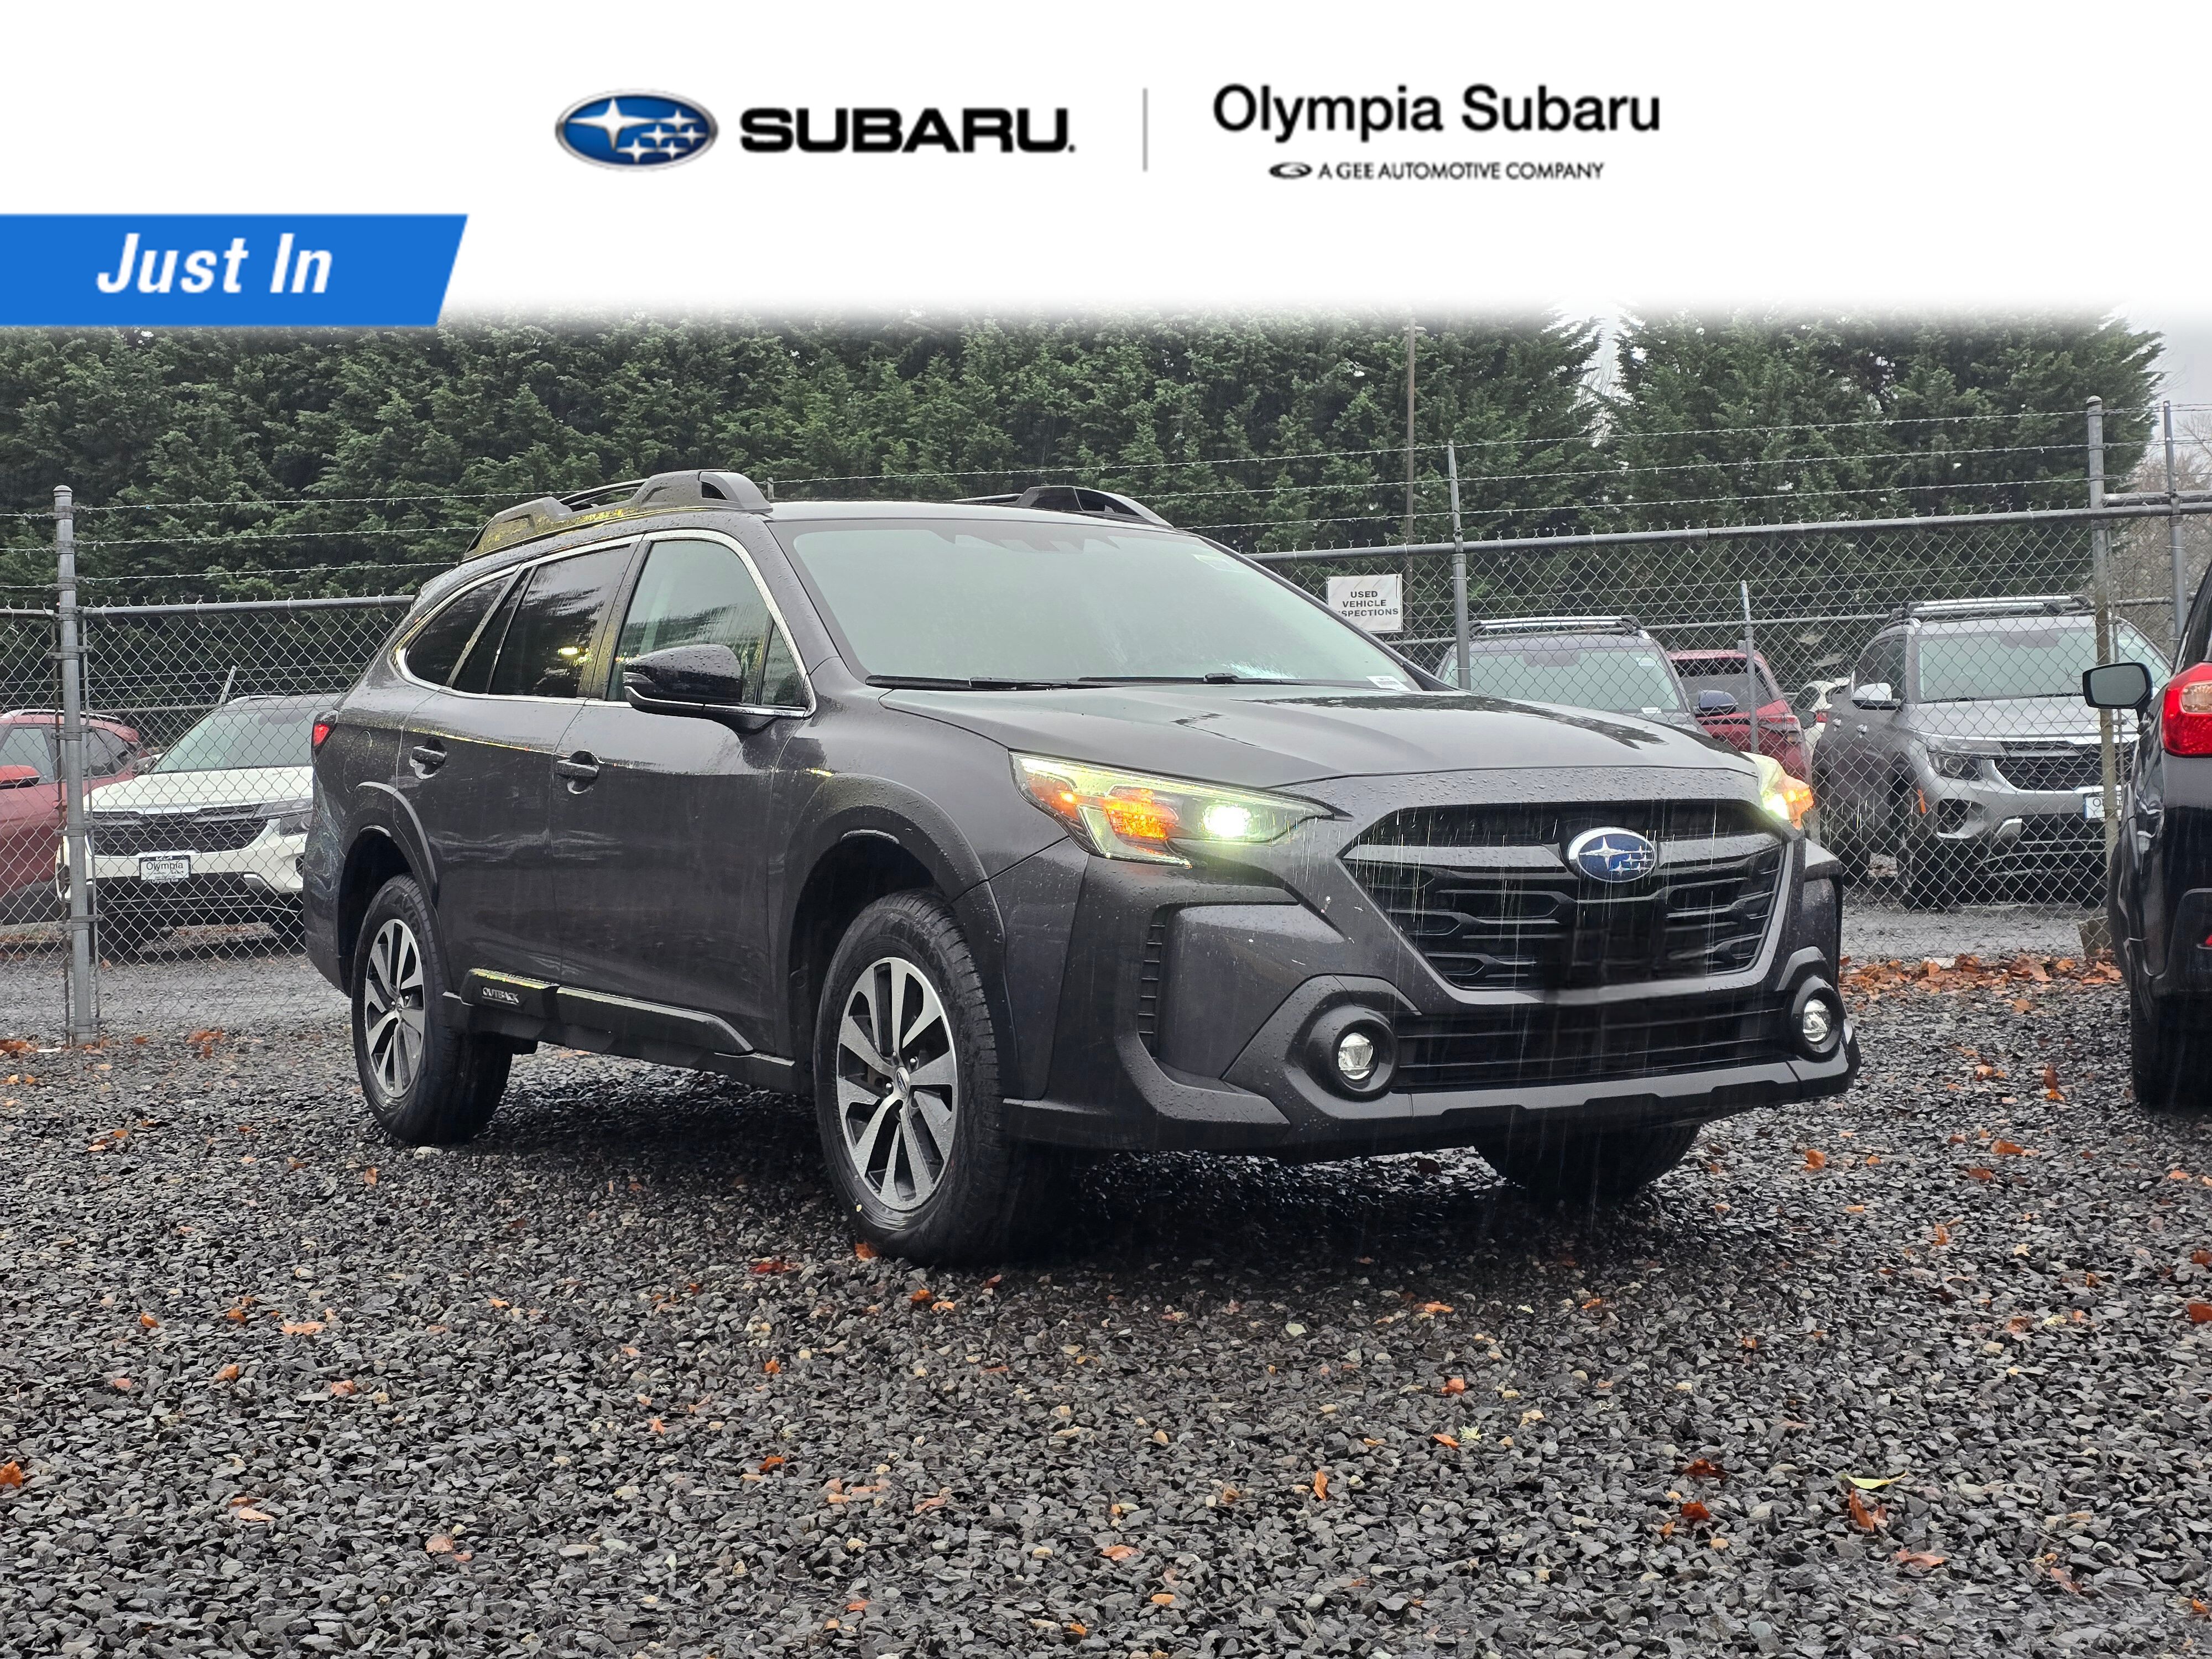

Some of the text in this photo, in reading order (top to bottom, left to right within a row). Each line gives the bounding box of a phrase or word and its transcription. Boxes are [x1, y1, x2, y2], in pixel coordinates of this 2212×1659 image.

[1342, 599, 1387, 608] VEHICLE
[1338, 608, 1399, 617] SPECTIONS
[146, 861, 184, 872] Olympia
[482, 987, 520, 1004] OUTBACK
